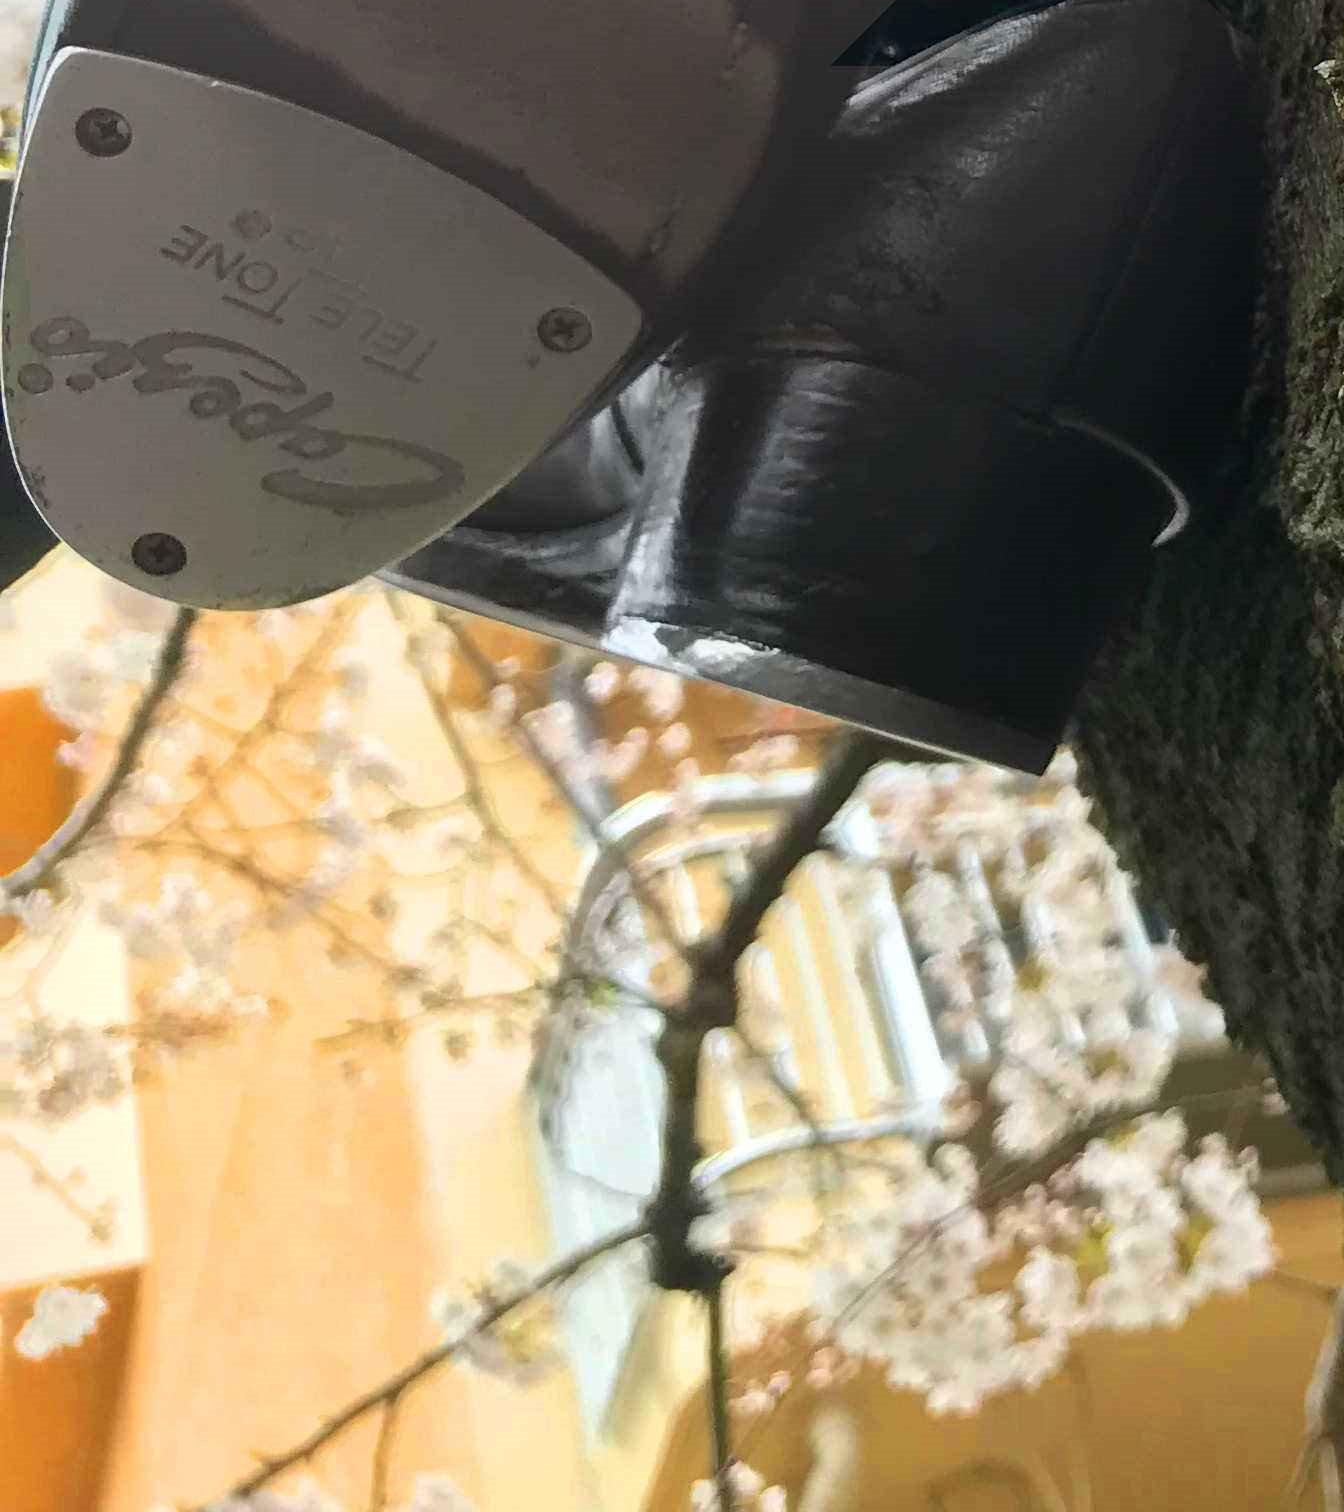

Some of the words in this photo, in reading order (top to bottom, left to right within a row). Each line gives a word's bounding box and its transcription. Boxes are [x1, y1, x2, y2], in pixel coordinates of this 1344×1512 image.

[161, 224, 302, 325] TONE
[308, 298, 439, 383] TELE
[30, 316, 466, 514] Capezio
